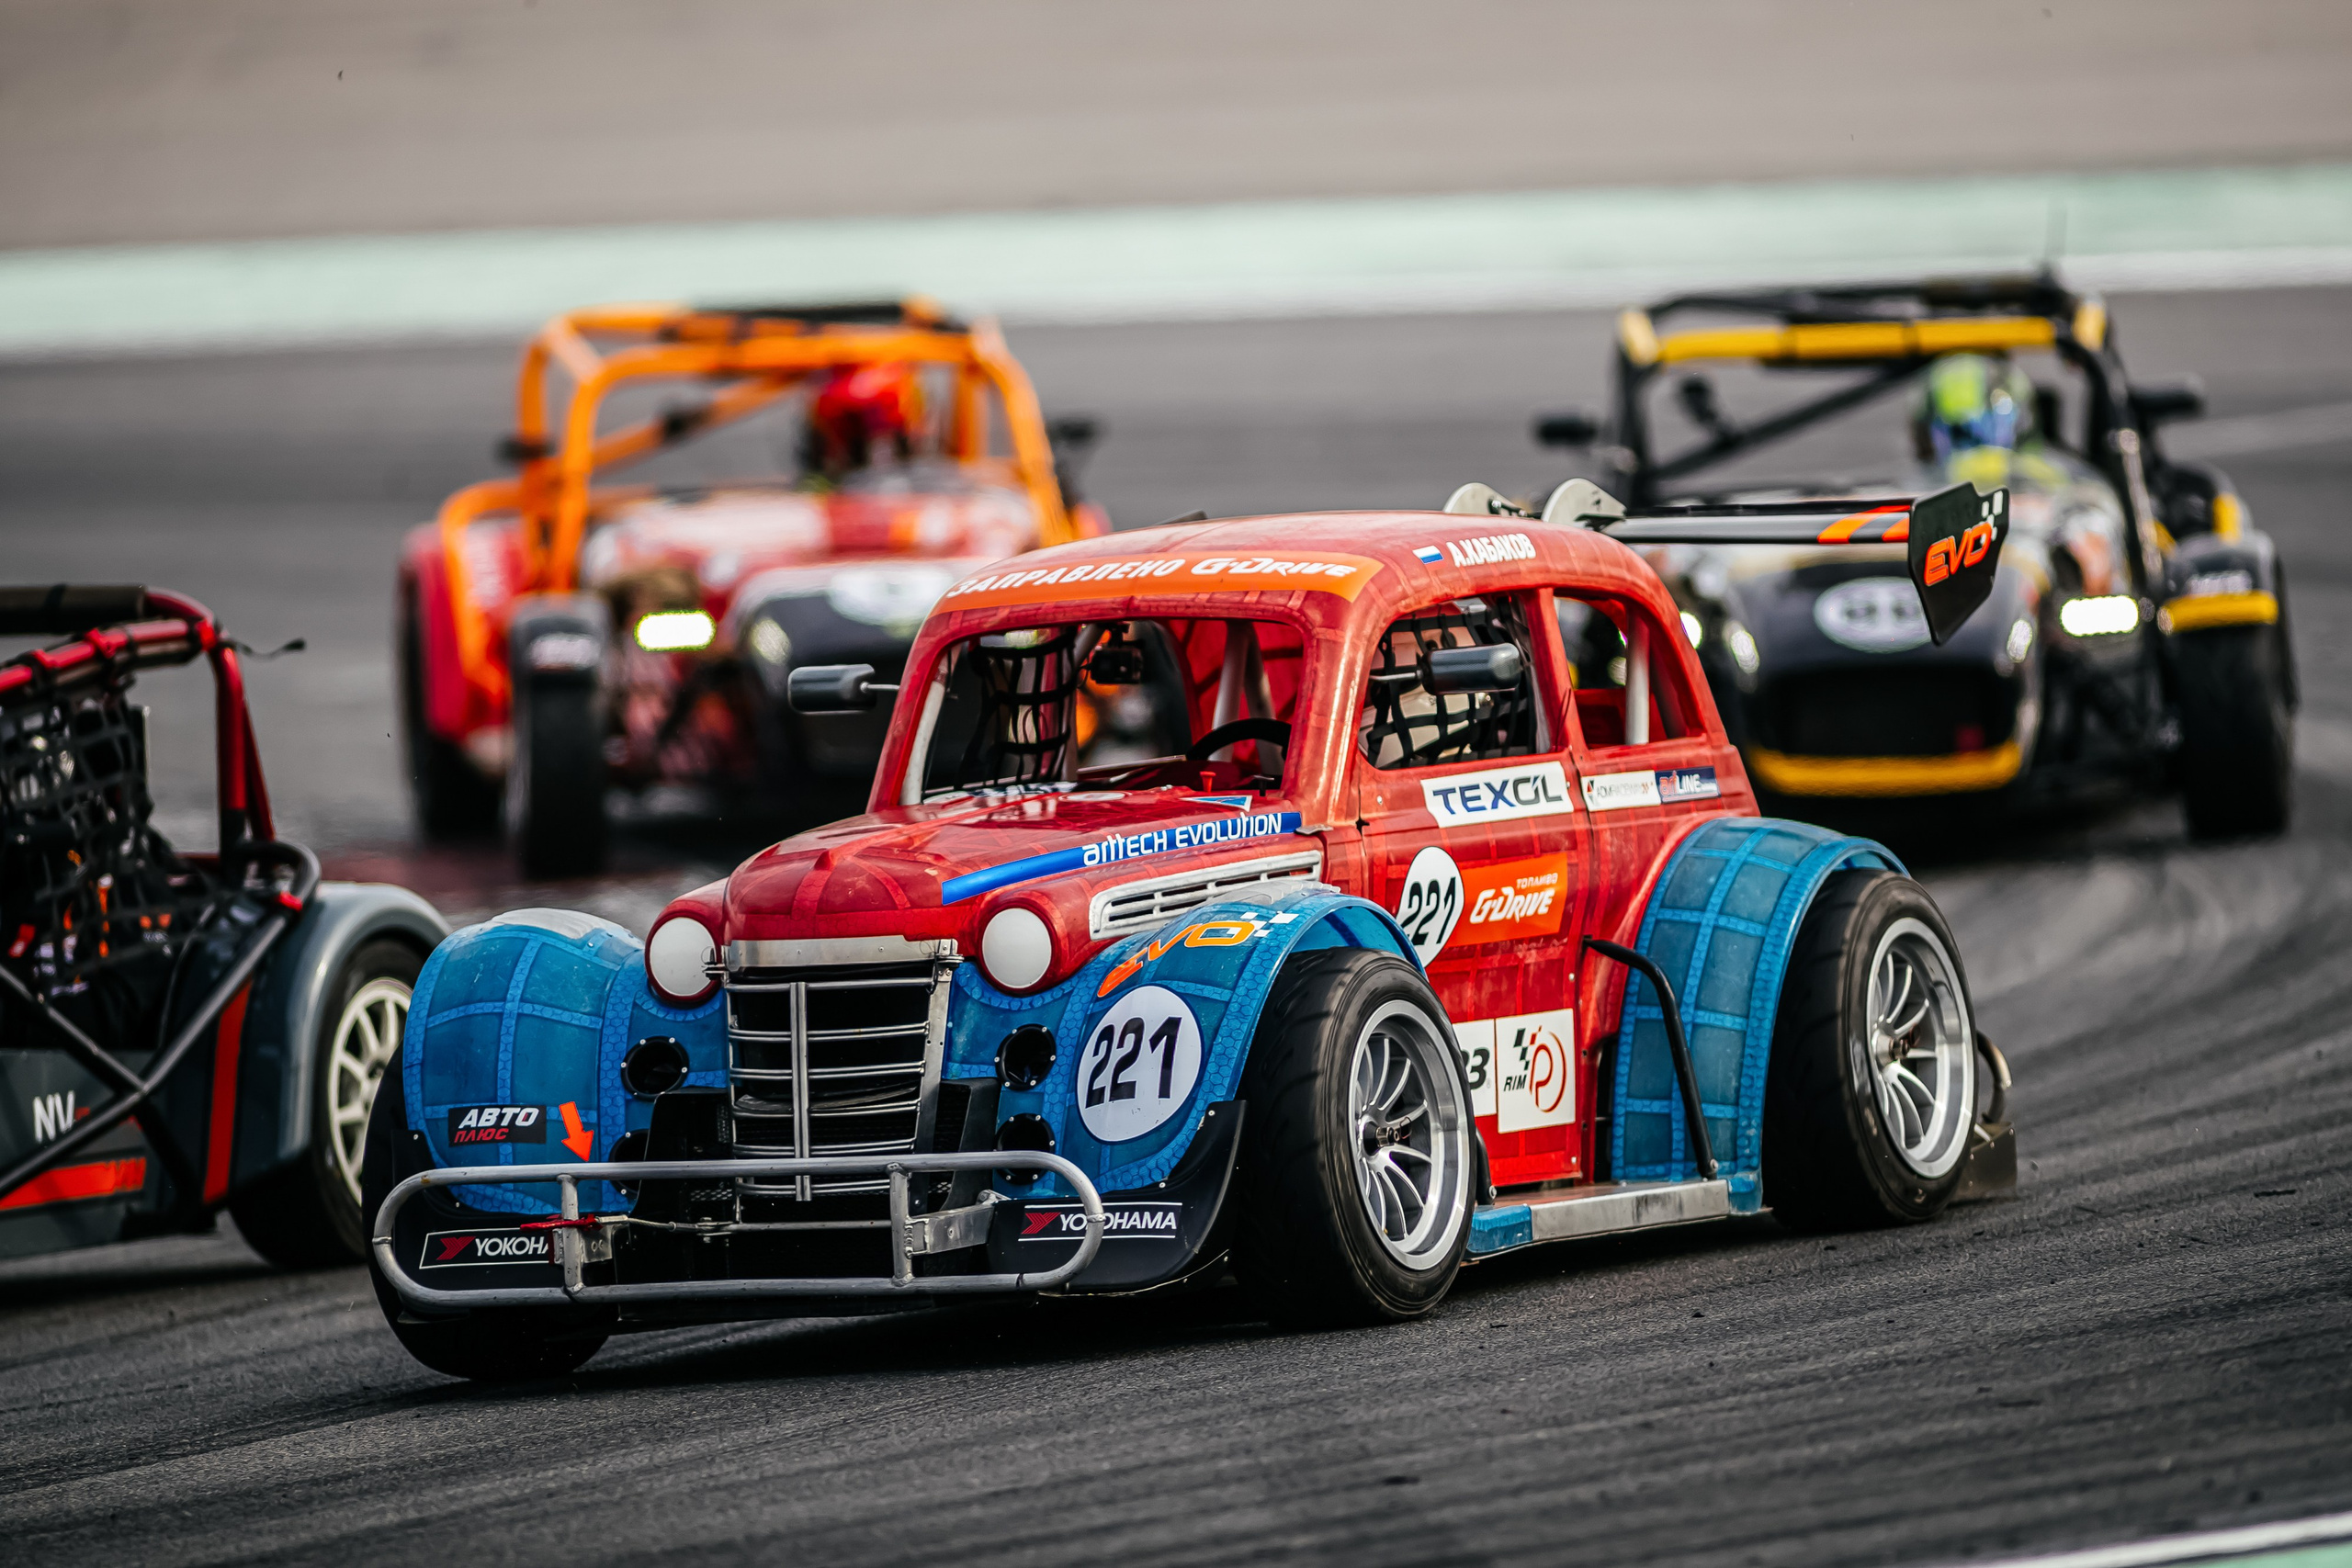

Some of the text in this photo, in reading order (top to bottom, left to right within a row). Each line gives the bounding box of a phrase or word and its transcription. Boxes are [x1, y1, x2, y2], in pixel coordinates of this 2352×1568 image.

[1924, 521, 1993, 587] EVO
[946, 558, 1186, 598] ЗАПРАВЛЕНО
[1400, 876, 1456, 946] 221
[1097, 920, 1256, 998] EVO
[1085, 1016, 1183, 1110] 221
[1502, 1074, 1528, 1092] RIM
[454, 1128, 510, 1144] ПЛЮС
[458, 1107, 540, 1129] АВТО
[1059, 1211, 1178, 1232] YOOHAMA
